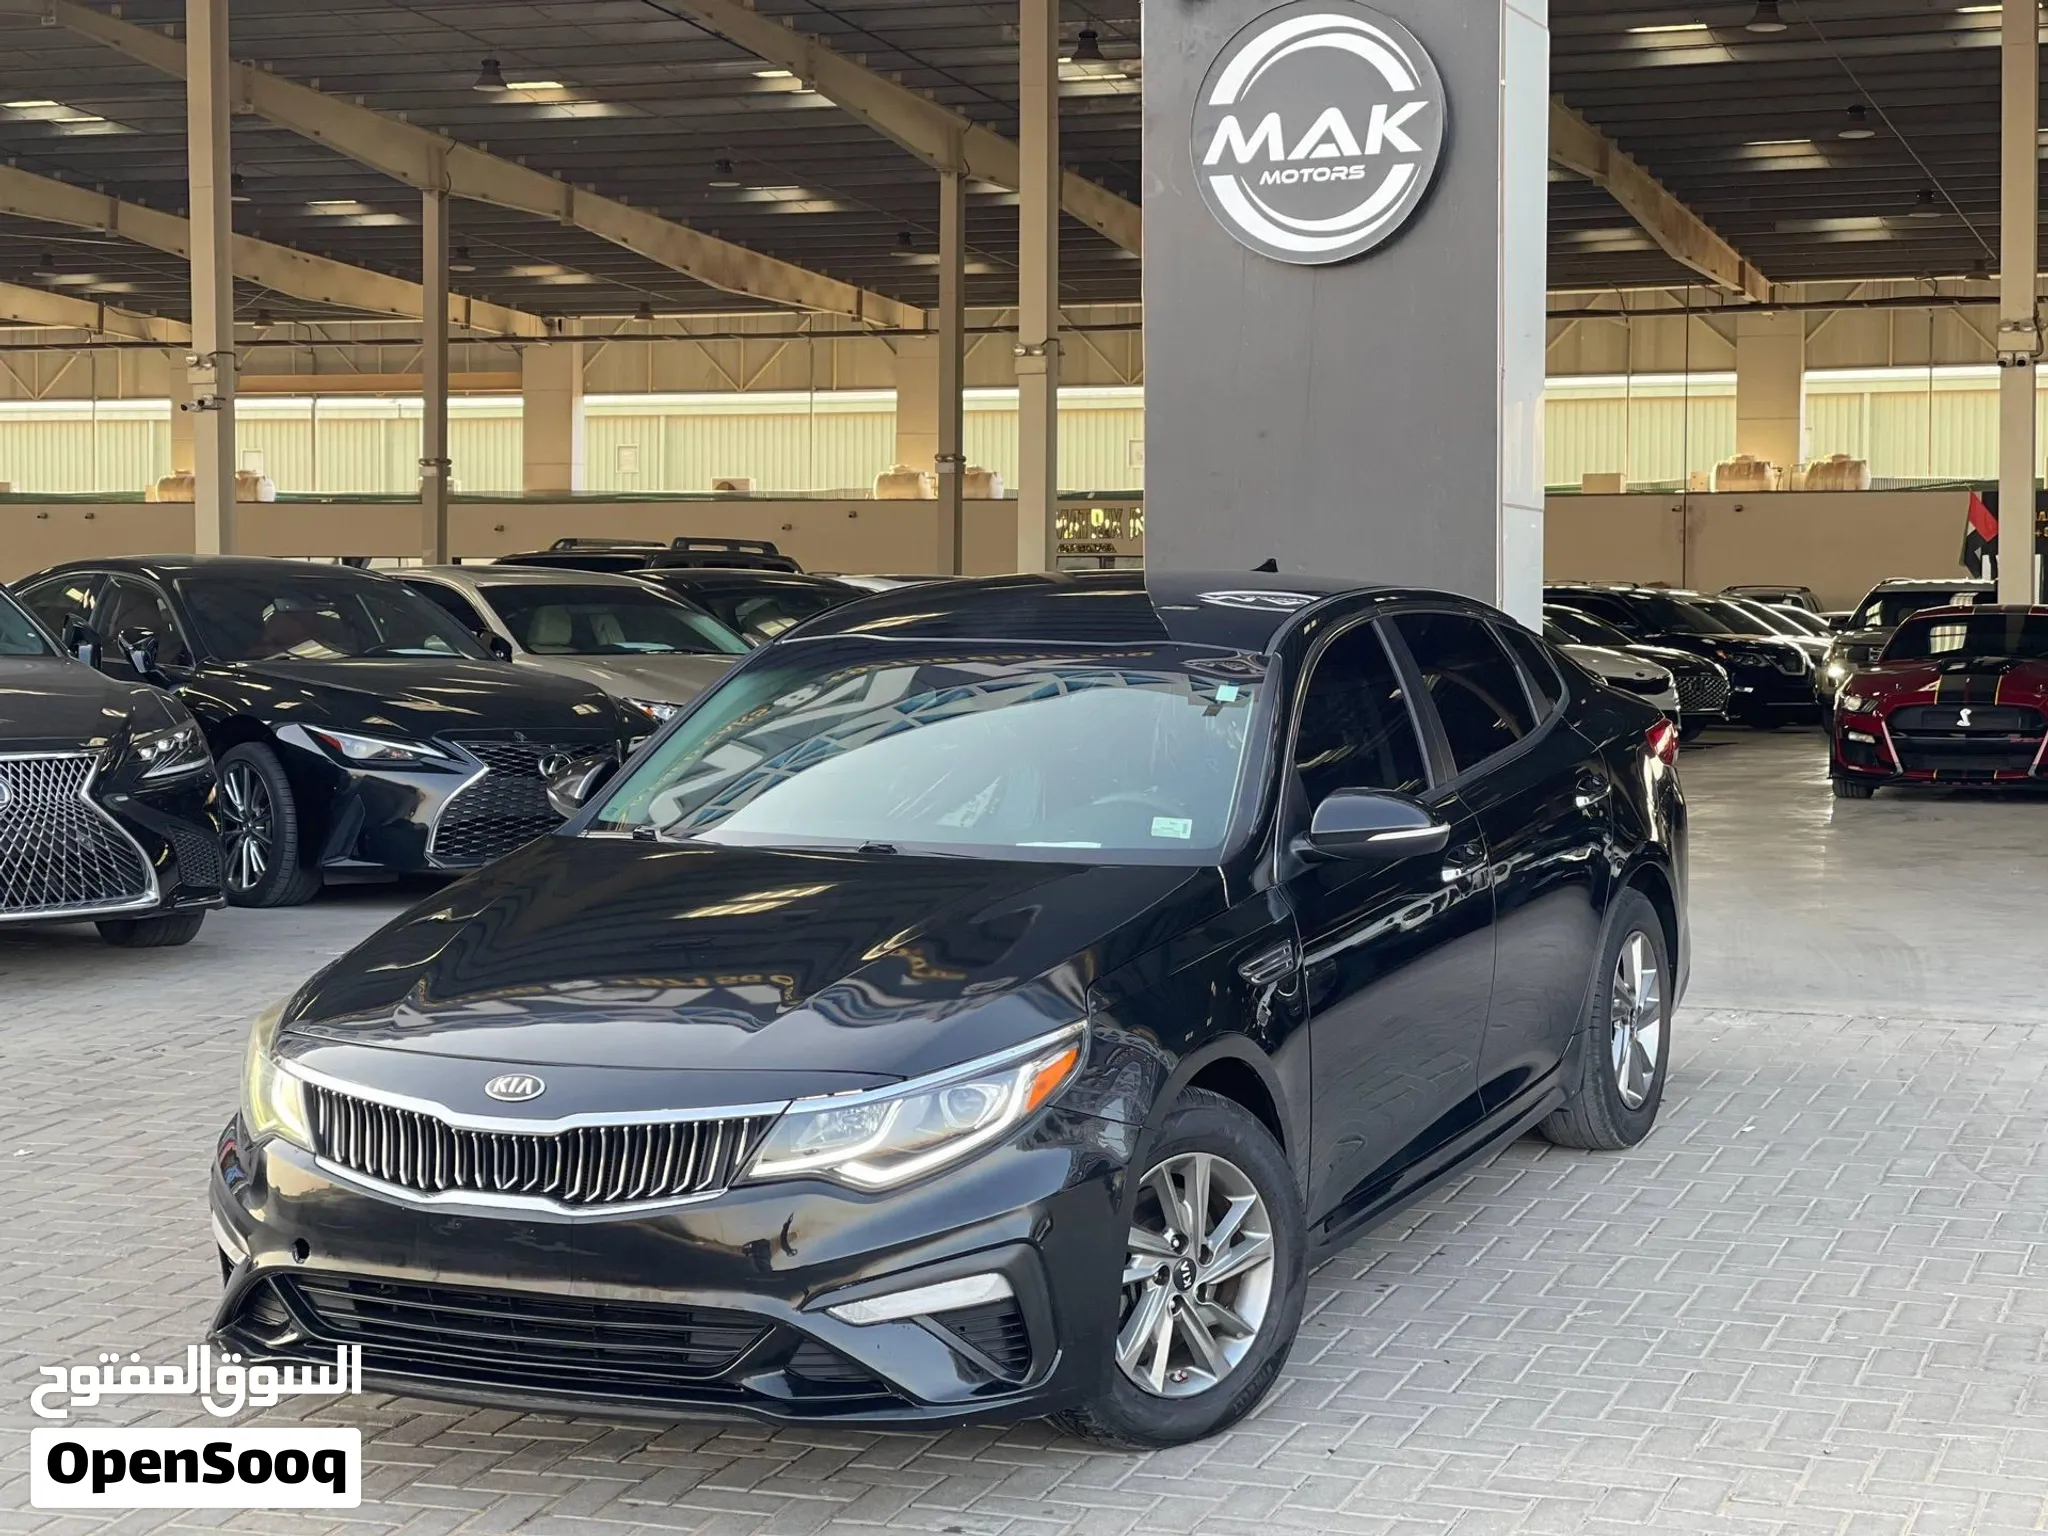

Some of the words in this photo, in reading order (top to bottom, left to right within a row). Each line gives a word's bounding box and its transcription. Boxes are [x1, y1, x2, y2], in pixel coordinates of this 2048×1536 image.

[1202, 100, 1430, 166] MAK
[1259, 164, 1366, 186] MOTORS
[493, 1077, 533, 1094] KIA
[1181, 1261, 1192, 1288] KIA
